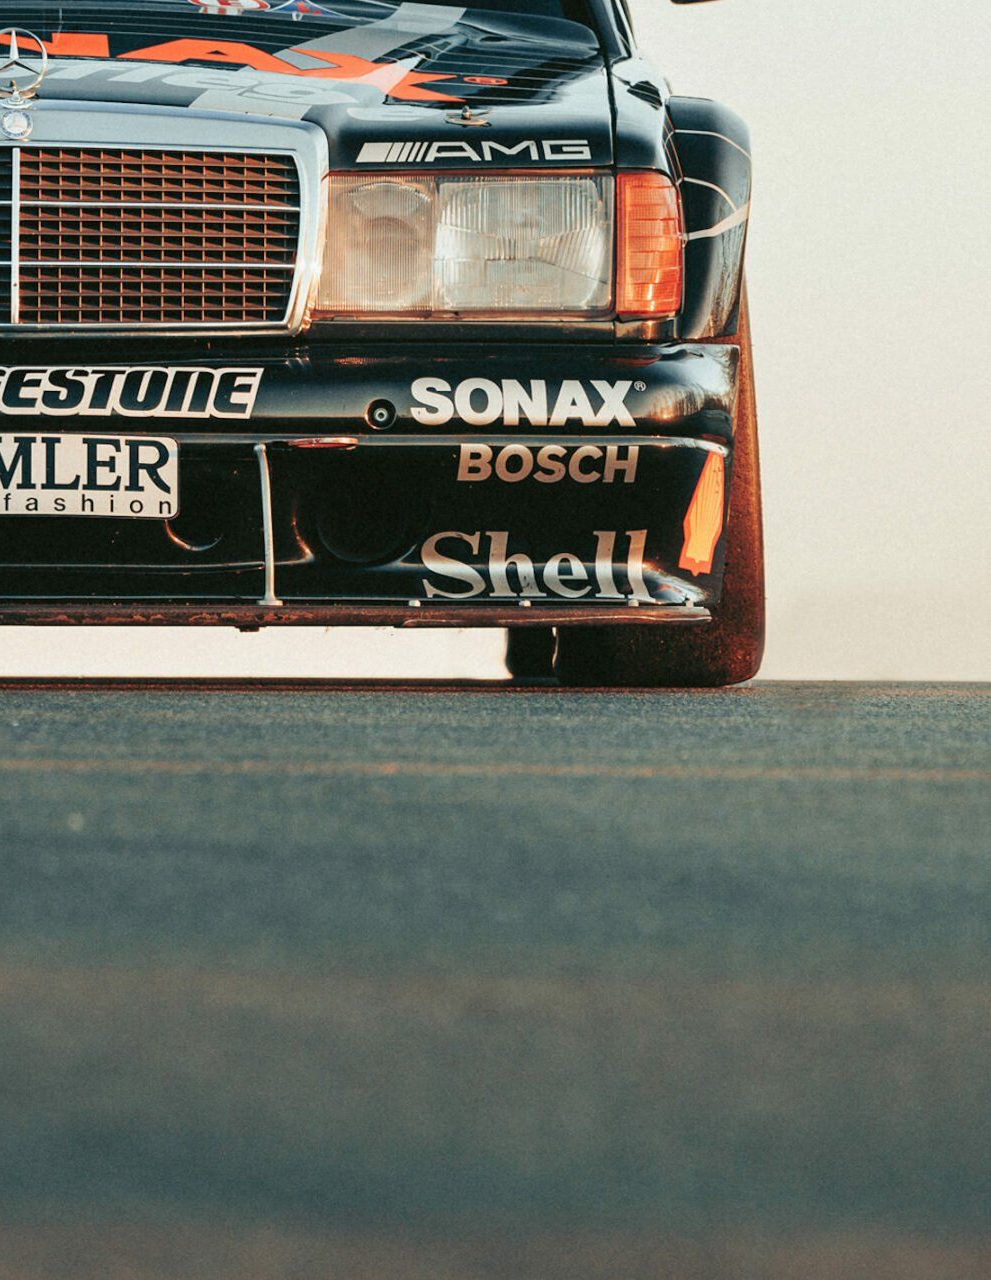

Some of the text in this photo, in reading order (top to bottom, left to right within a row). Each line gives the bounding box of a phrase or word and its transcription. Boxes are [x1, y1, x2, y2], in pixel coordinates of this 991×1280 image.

[423, 139, 592, 162] AMG
[457, 444, 639, 483] BOSCH
[4, 492, 171, 514] fashion
[420, 529, 656, 603] Shell
